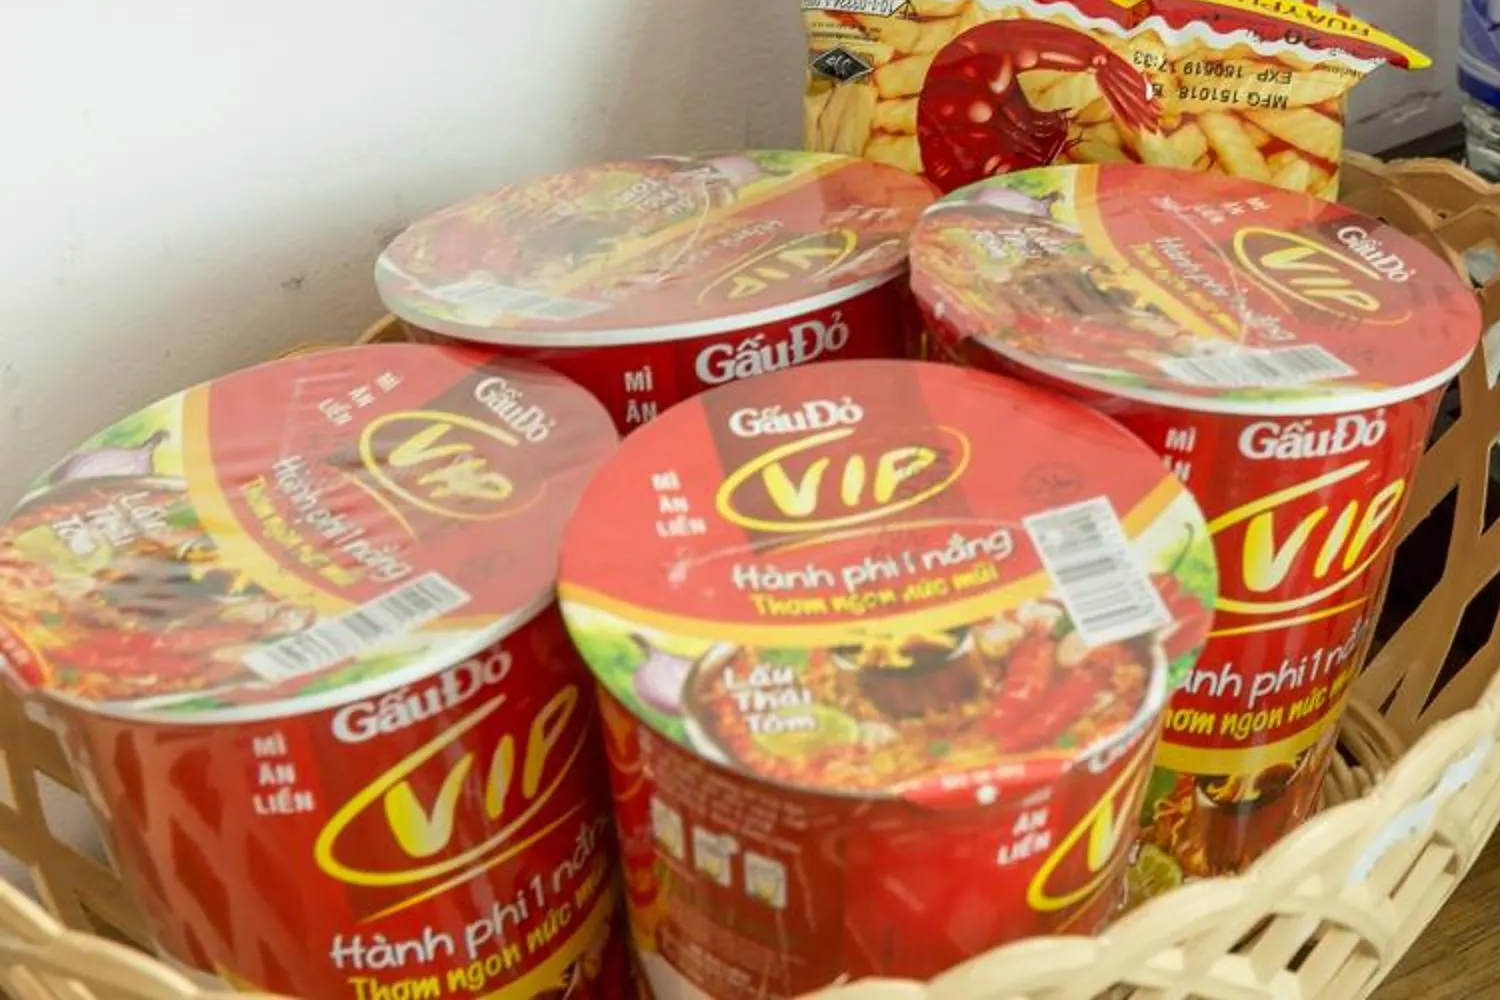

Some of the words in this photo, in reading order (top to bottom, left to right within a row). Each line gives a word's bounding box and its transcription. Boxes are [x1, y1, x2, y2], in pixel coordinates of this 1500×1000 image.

[1247, 92, 1289, 110] MFG
[1256, 69, 1293, 85] EXP
[1259, 243, 1381, 312] VIP
[1164, 426, 1197, 452] MÌ
[1239, 409, 1387, 462] GấuĐỏ
[761, 446, 938, 517] VIP
[1242, 478, 1406, 593] VIP
[1247, 655, 1309, 710] phi
[253, 730, 288, 757] MÌ
[1219, 705, 1285, 741] ngon
[383, 683, 578, 859] VIP
[329, 926, 456, 970] Hành
[464, 889, 529, 960] phi
[446, 943, 524, 997] ngon
